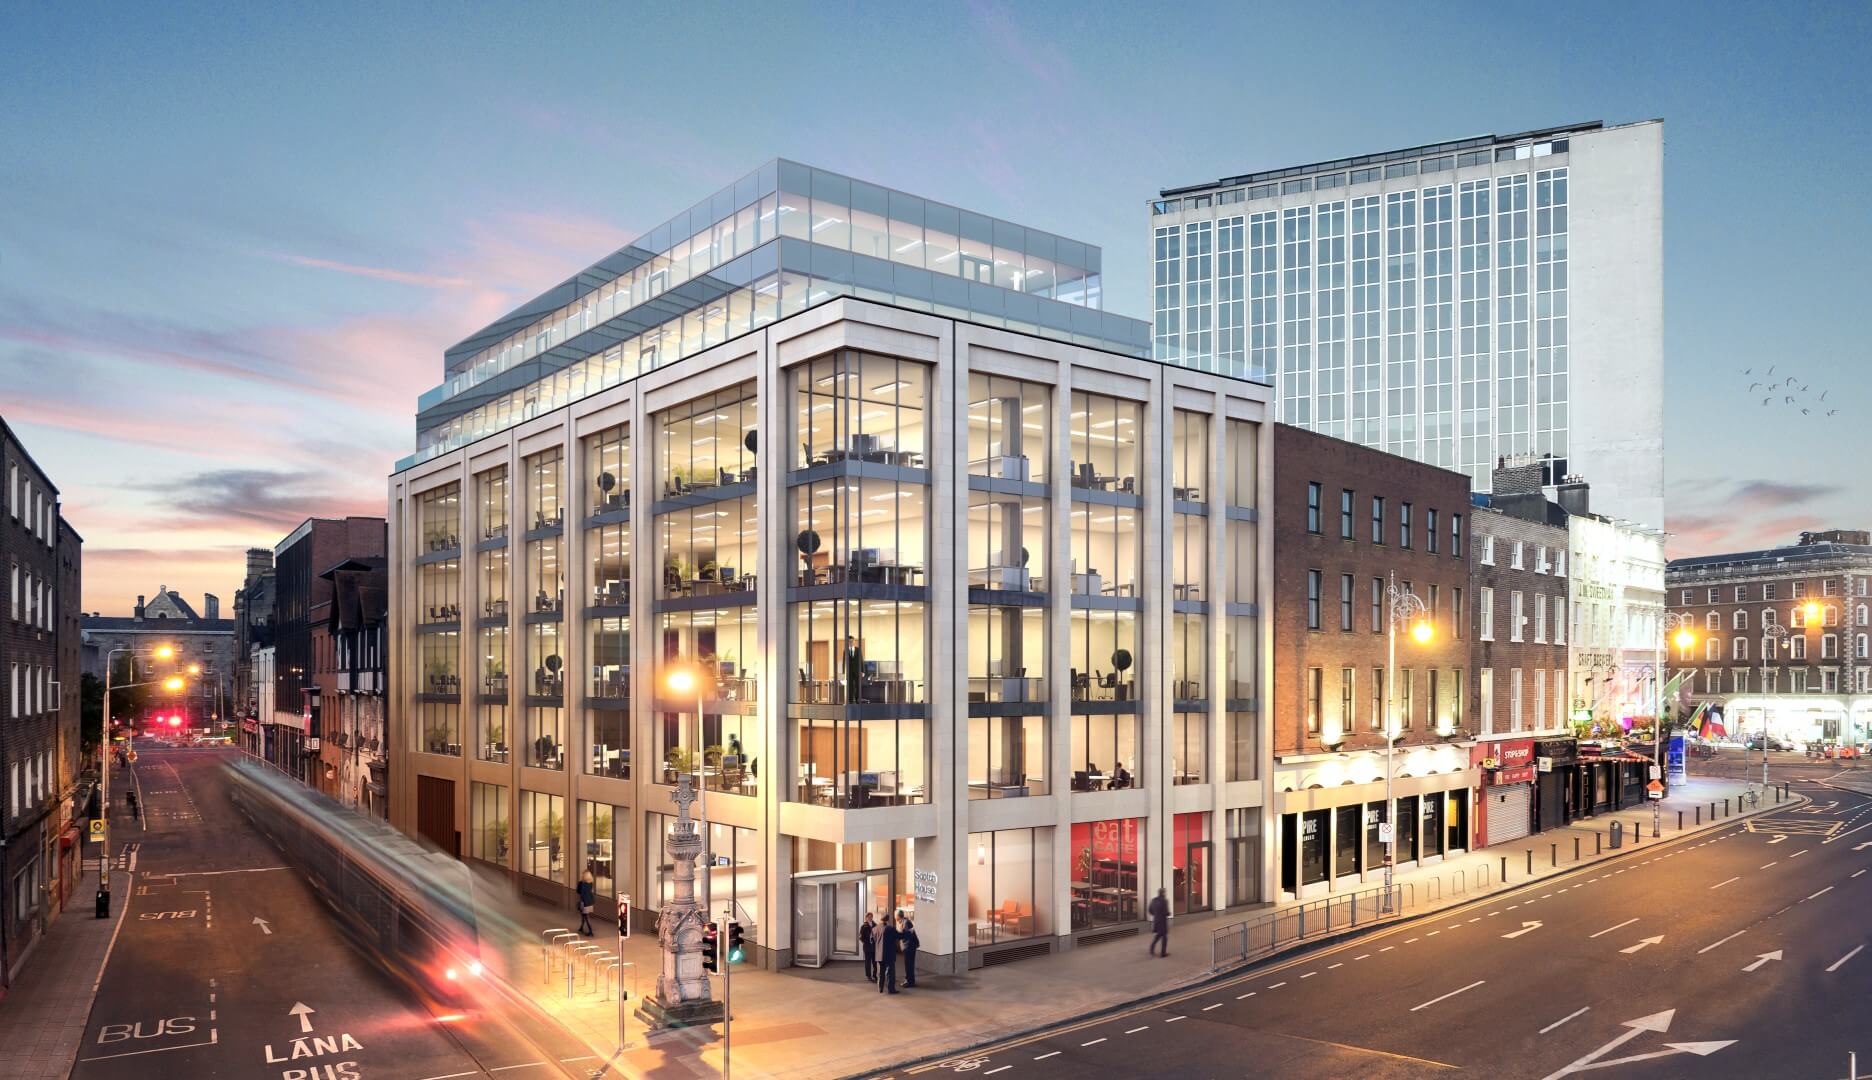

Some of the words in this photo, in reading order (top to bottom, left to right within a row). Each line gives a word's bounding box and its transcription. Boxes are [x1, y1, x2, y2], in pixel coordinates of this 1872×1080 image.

[1094, 819, 1134, 842] eat
[914, 882, 936, 895] House
[139, 909, 198, 921] BUS
[97, 1017, 196, 1045] BUS
